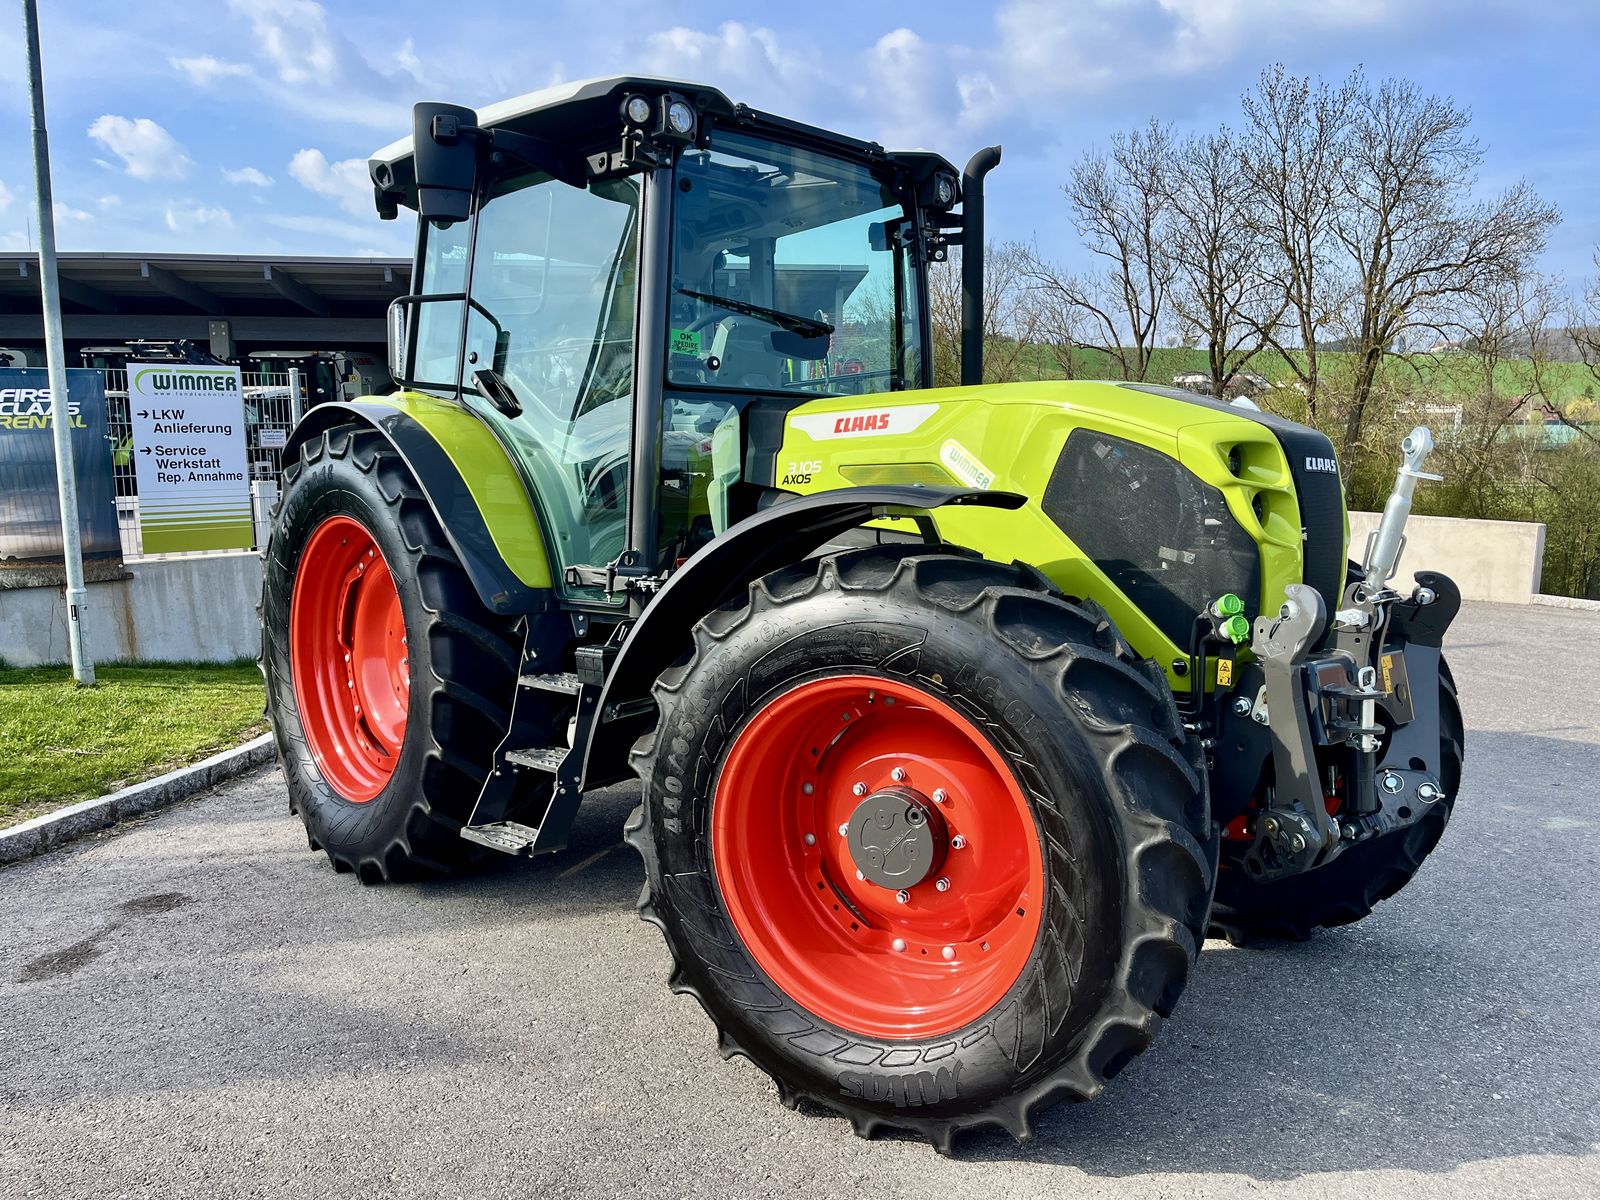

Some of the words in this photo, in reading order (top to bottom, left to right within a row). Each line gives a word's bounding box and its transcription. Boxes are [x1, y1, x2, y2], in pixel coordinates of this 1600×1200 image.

[680, 332, 693, 341] OK
[152, 374, 237, 392] WIMMER
[0, 388, 70, 403] FIRS
[152, 409, 185, 420] LKW
[153, 422, 232, 436] Anlieferung
[834, 413, 890, 434] CLAAS
[155, 445, 207, 456] Service
[155, 458, 222, 470] Werkstatt
[788, 460, 823, 475] 3.105
[949, 447, 990, 489] WIMMER
[1305, 456, 1337, 472] CLAAS
[157, 472, 185, 485] Rep.
[187, 471, 244, 482] Annahme
[781, 473, 812, 486] AXOS
